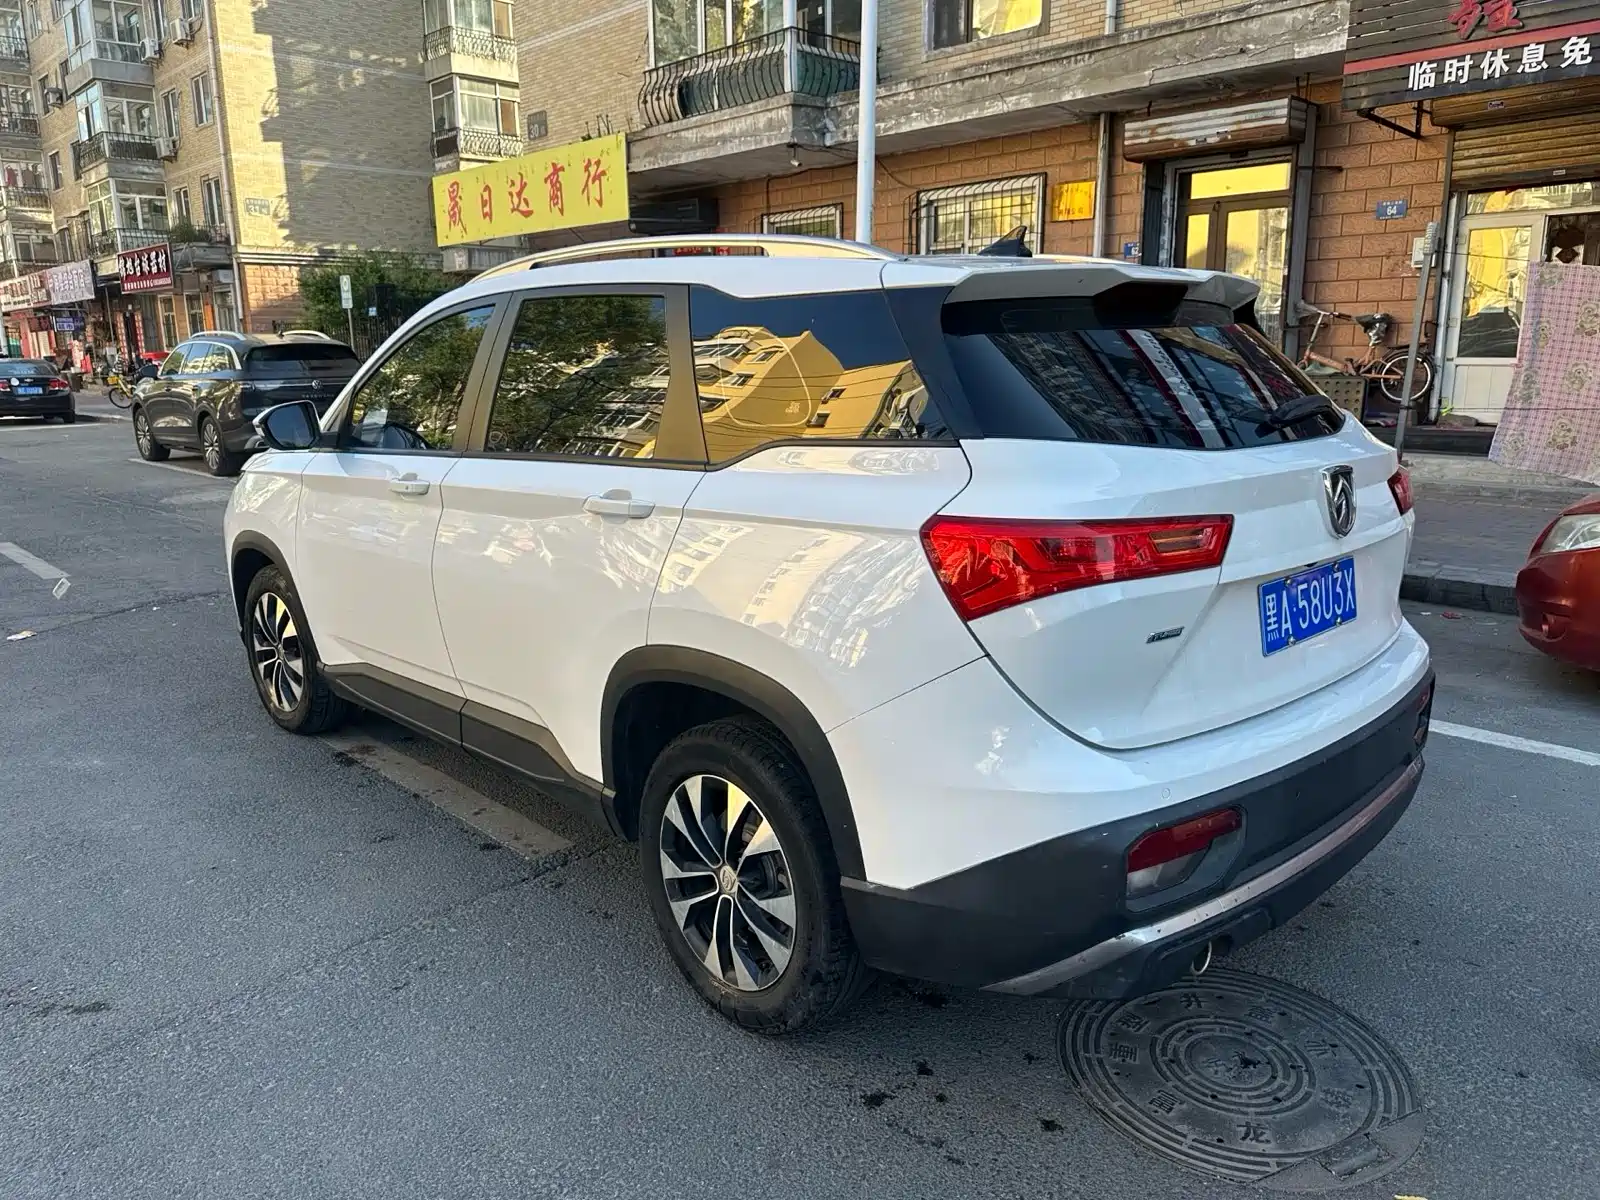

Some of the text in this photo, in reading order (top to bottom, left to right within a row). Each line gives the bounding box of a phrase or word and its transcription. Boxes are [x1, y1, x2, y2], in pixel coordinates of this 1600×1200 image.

[1407, 36, 1593, 91] 临时休息免
[447, 158, 607, 236] 晟日达商行
[1386, 205, 1397, 216] 64
